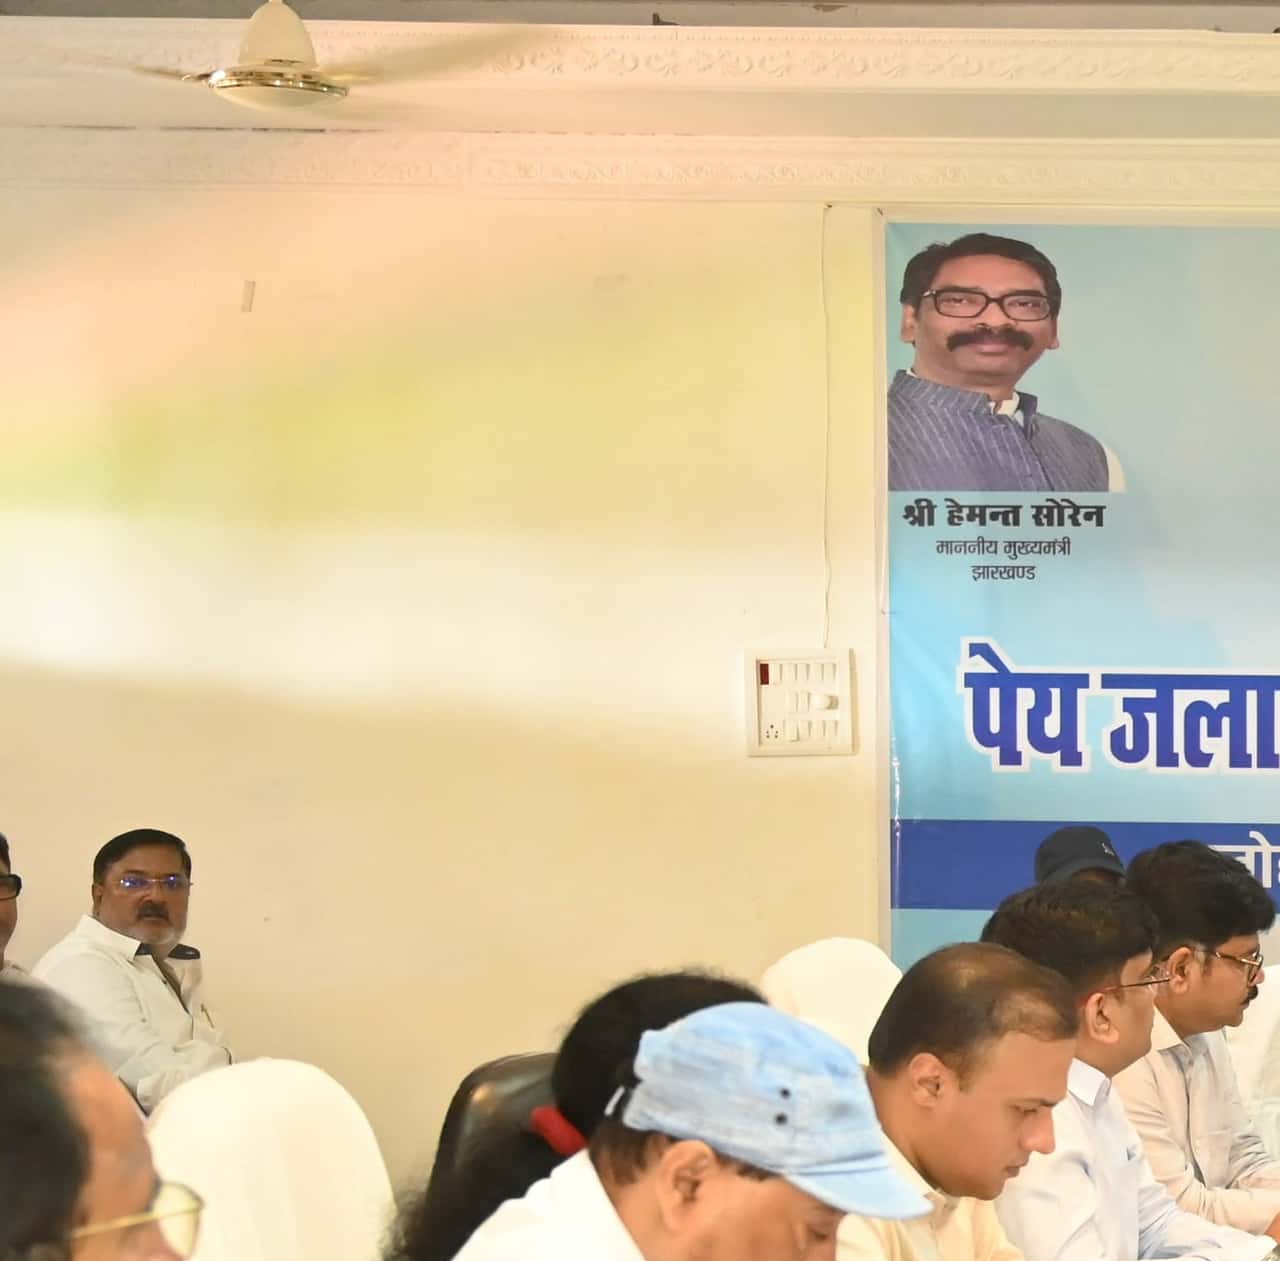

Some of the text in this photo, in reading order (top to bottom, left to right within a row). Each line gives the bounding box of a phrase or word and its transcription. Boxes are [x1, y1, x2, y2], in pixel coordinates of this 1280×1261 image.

[903, 498, 1107, 527] श्री हेमन्त सोरेन
[936, 537, 1071, 560] माननीय मुख्यमंत्री
[971, 565, 1037, 582] झारखण्ड
[963, 642, 1089, 768] पेय
